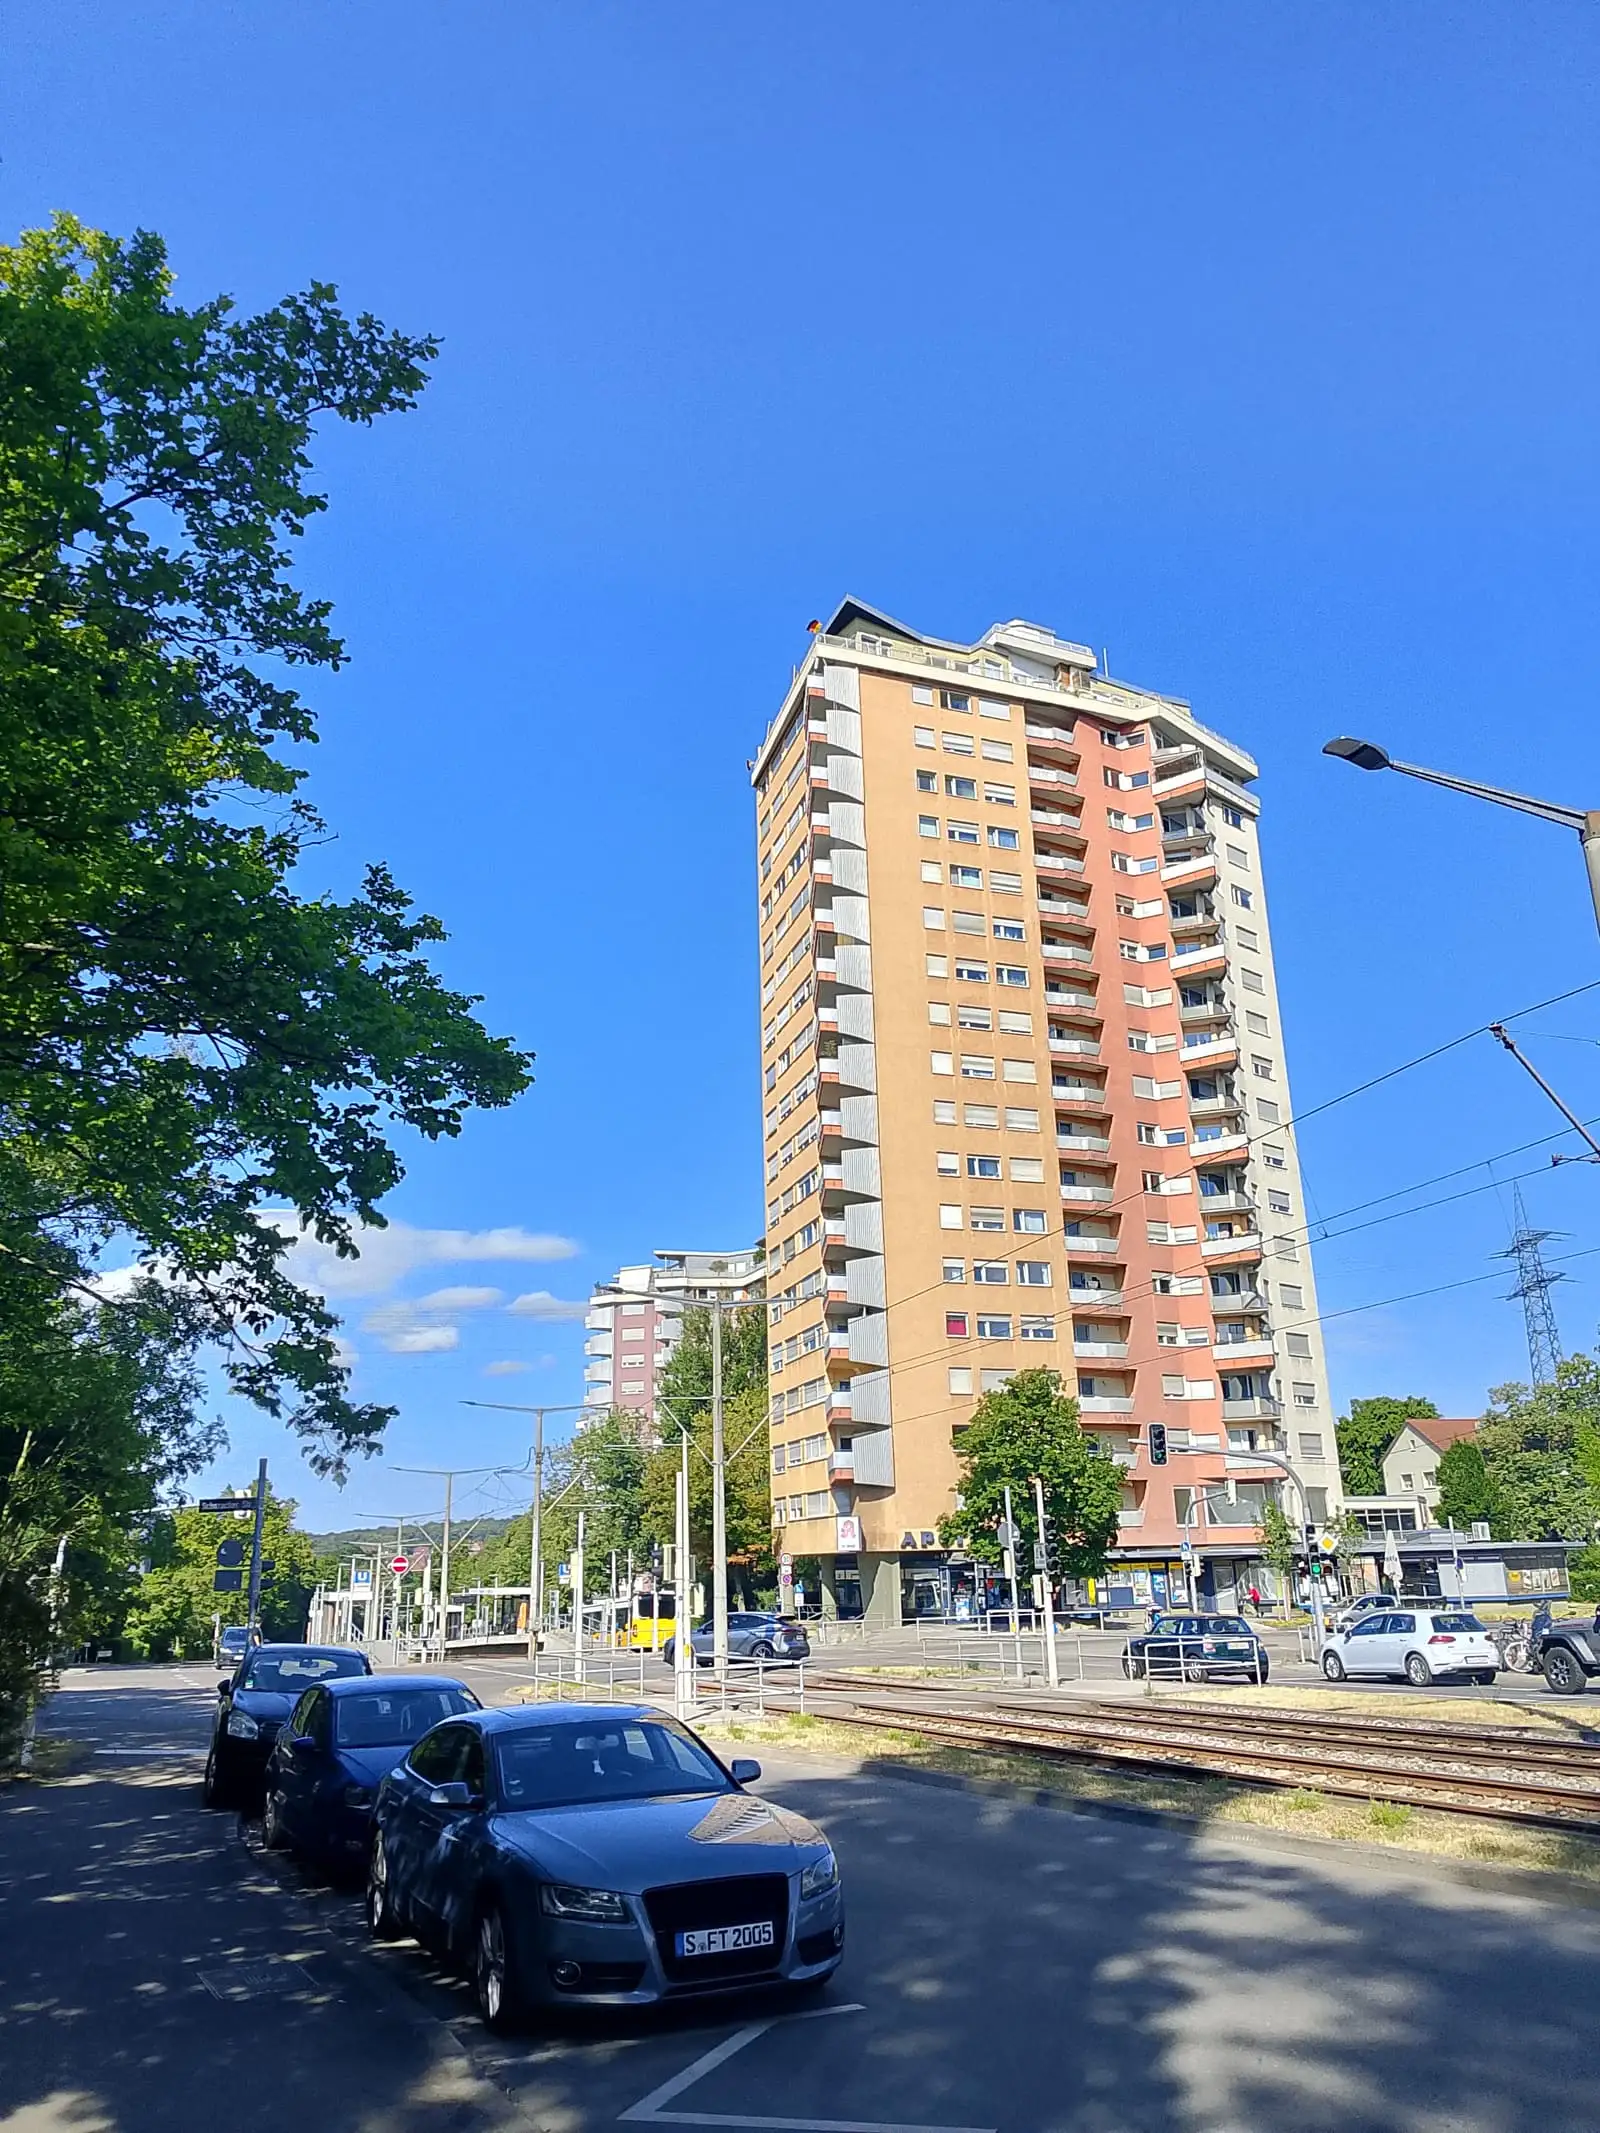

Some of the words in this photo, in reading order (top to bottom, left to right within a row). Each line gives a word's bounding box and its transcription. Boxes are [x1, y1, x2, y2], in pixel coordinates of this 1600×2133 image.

[358, 1571, 368, 1581] U
[686, 1934, 696, 1954] S
[707, 1930, 728, 1951] FT
[733, 1923, 772, 1947] 2005
